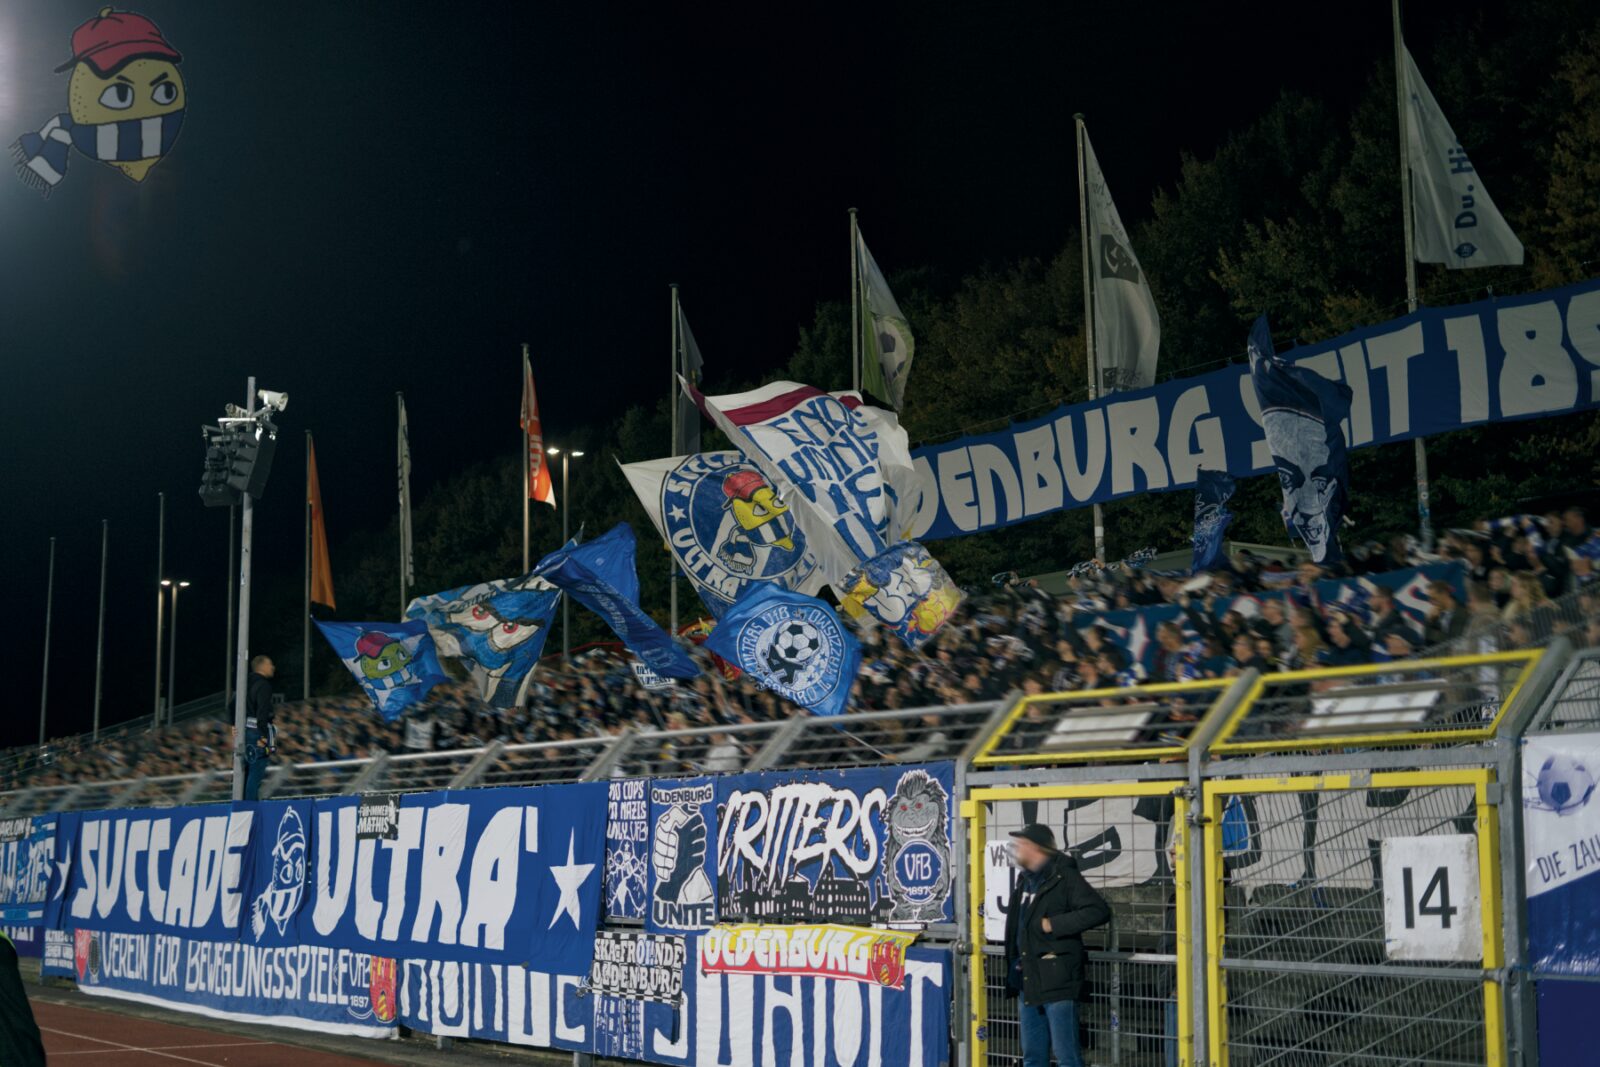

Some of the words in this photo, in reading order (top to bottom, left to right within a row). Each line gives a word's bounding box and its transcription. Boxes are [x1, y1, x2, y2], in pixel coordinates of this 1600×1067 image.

[1454, 184, 1478, 229] Du.
[622, 780, 645, 800] COPS
[652, 789, 712, 803] OLDENBURG
[620, 801, 647, 820] NAZIS
[357, 816, 389, 834] MATHIS
[71, 811, 254, 928] SUCCADE
[903, 852, 931, 880] VfB
[1536, 850, 1567, 883] DIE
[906, 886, 930, 896] 1897
[1402, 866, 1458, 928] 14
[654, 901, 716, 927] UNITE
[102, 931, 150, 981] VEREIN
[593, 961, 681, 996] OLDENBURG
[349, 995, 369, 1008] 1897
